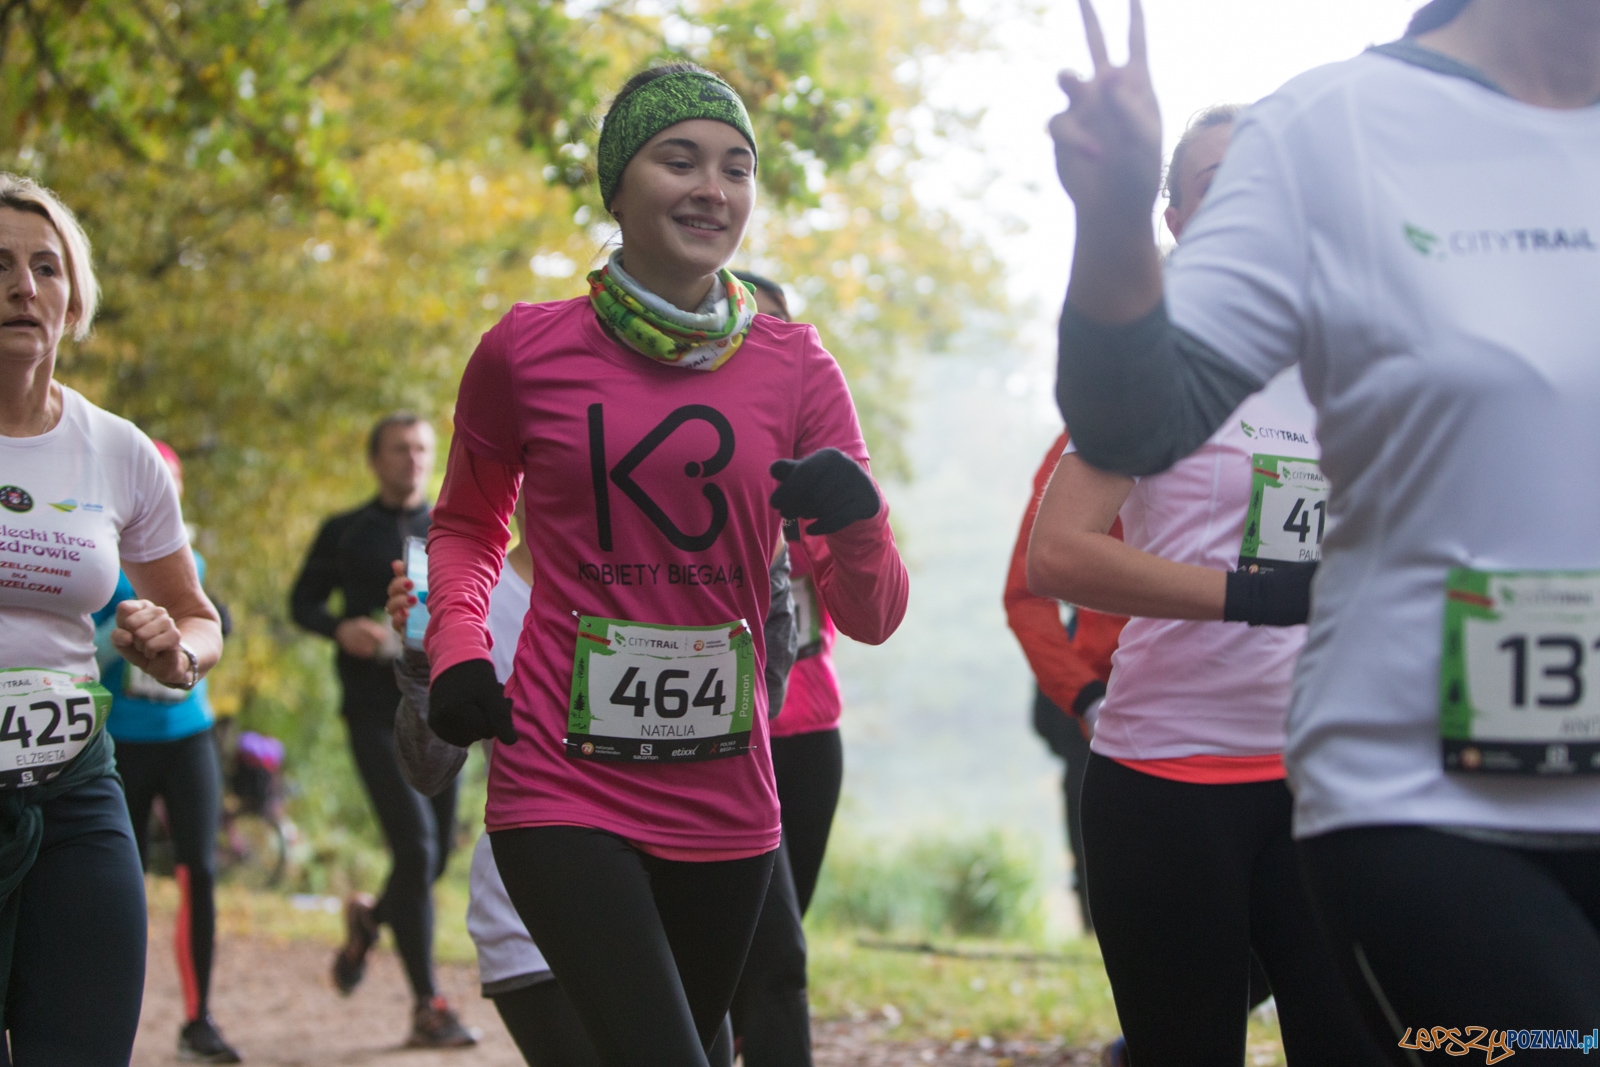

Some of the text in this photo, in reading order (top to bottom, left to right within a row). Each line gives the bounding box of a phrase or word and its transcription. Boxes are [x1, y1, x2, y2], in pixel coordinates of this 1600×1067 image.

[1259, 427, 1309, 444] CITYTRAiL
[0, 525, 96, 549] lecki Kros
[0, 561, 72, 578] ZELCZANIE
[11, 572, 28, 580] DLA
[577, 560, 744, 589] KOBIETY BIEGAJĄ
[628, 637, 679, 650] CITYTRAiL
[1498, 633, 1600, 708] 13
[609, 666, 727, 719] 464
[739, 674, 750, 717] Poznań
[0, 696, 93, 748] 425
[640, 724, 696, 737] NATALIA
